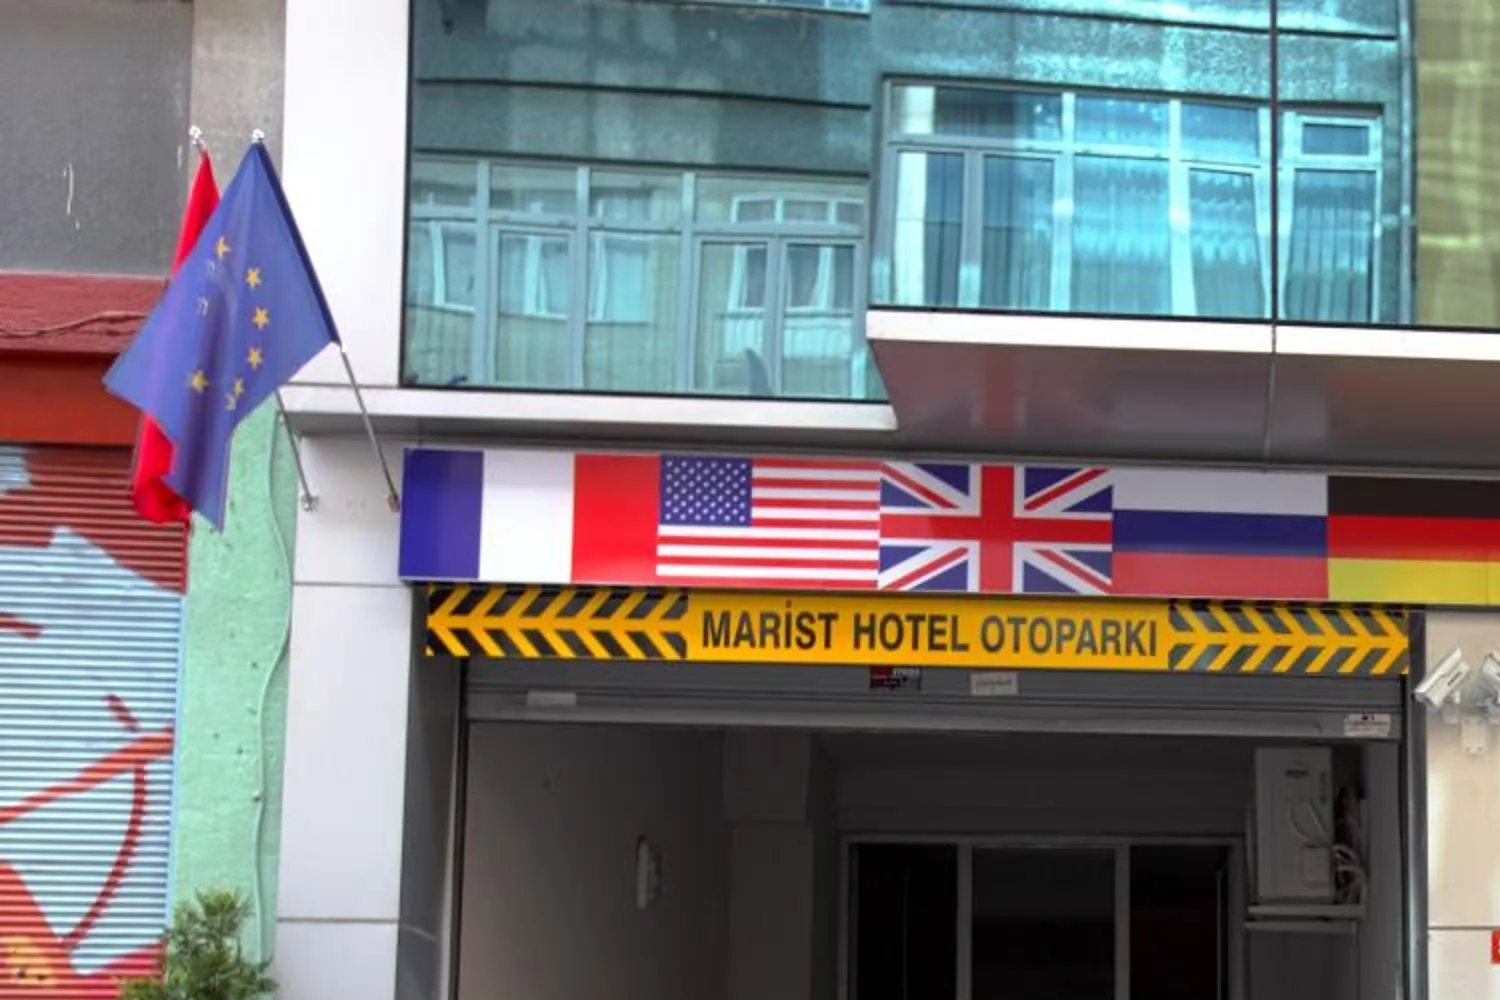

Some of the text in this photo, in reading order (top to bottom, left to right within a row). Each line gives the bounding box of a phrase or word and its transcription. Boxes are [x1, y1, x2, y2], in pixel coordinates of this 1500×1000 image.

[702, 600, 1157, 657] MARİST HOTEL OTOPARKI
